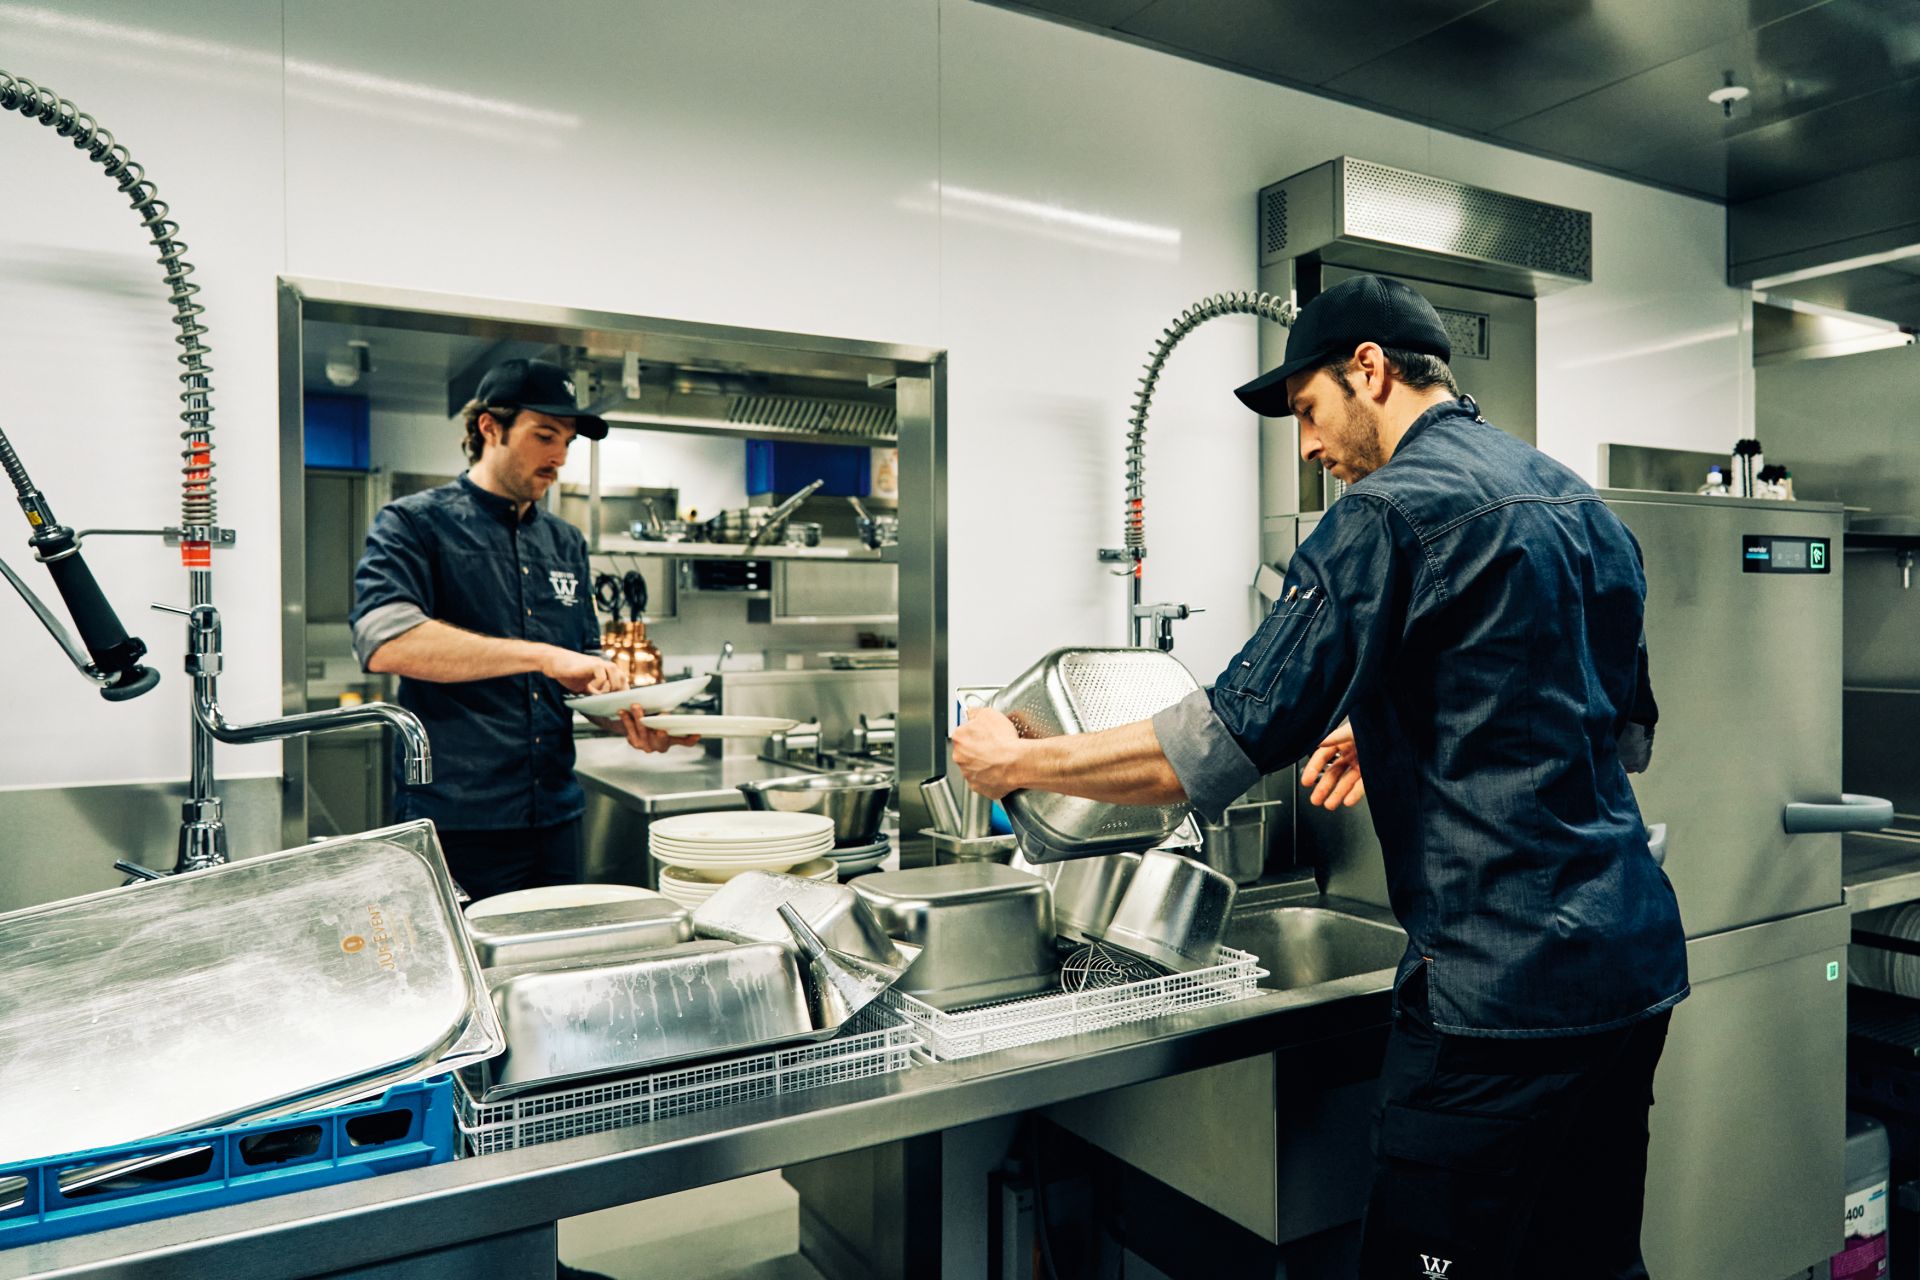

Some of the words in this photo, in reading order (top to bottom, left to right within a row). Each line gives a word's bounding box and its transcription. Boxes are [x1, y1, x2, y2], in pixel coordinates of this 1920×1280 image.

[549, 577, 578, 596] W
[1846, 1204, 1864, 1221] 400
[1420, 1253, 1453, 1274] W
